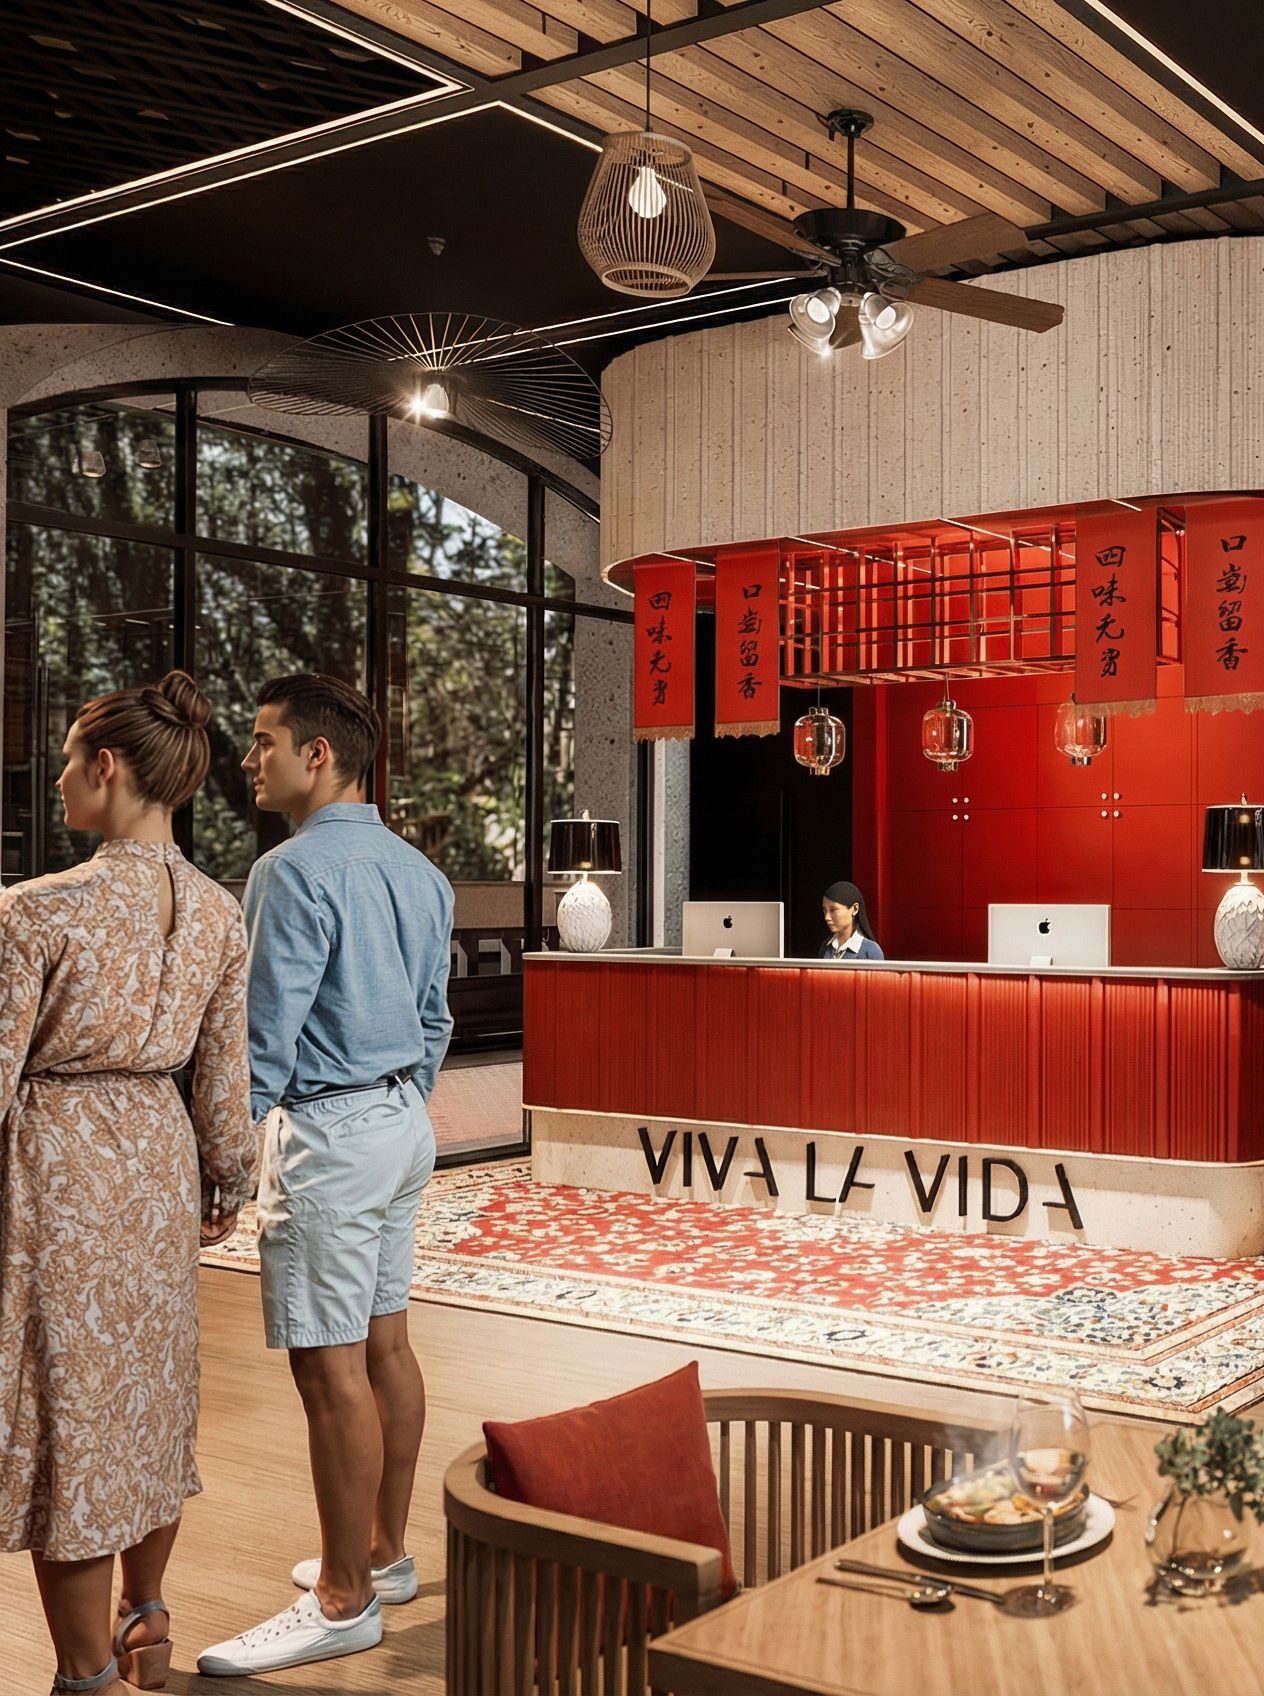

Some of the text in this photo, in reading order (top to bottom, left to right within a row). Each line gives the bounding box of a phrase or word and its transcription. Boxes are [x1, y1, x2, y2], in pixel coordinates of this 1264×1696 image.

[637, 1127, 1084, 1230] VIVA LA VIDA
